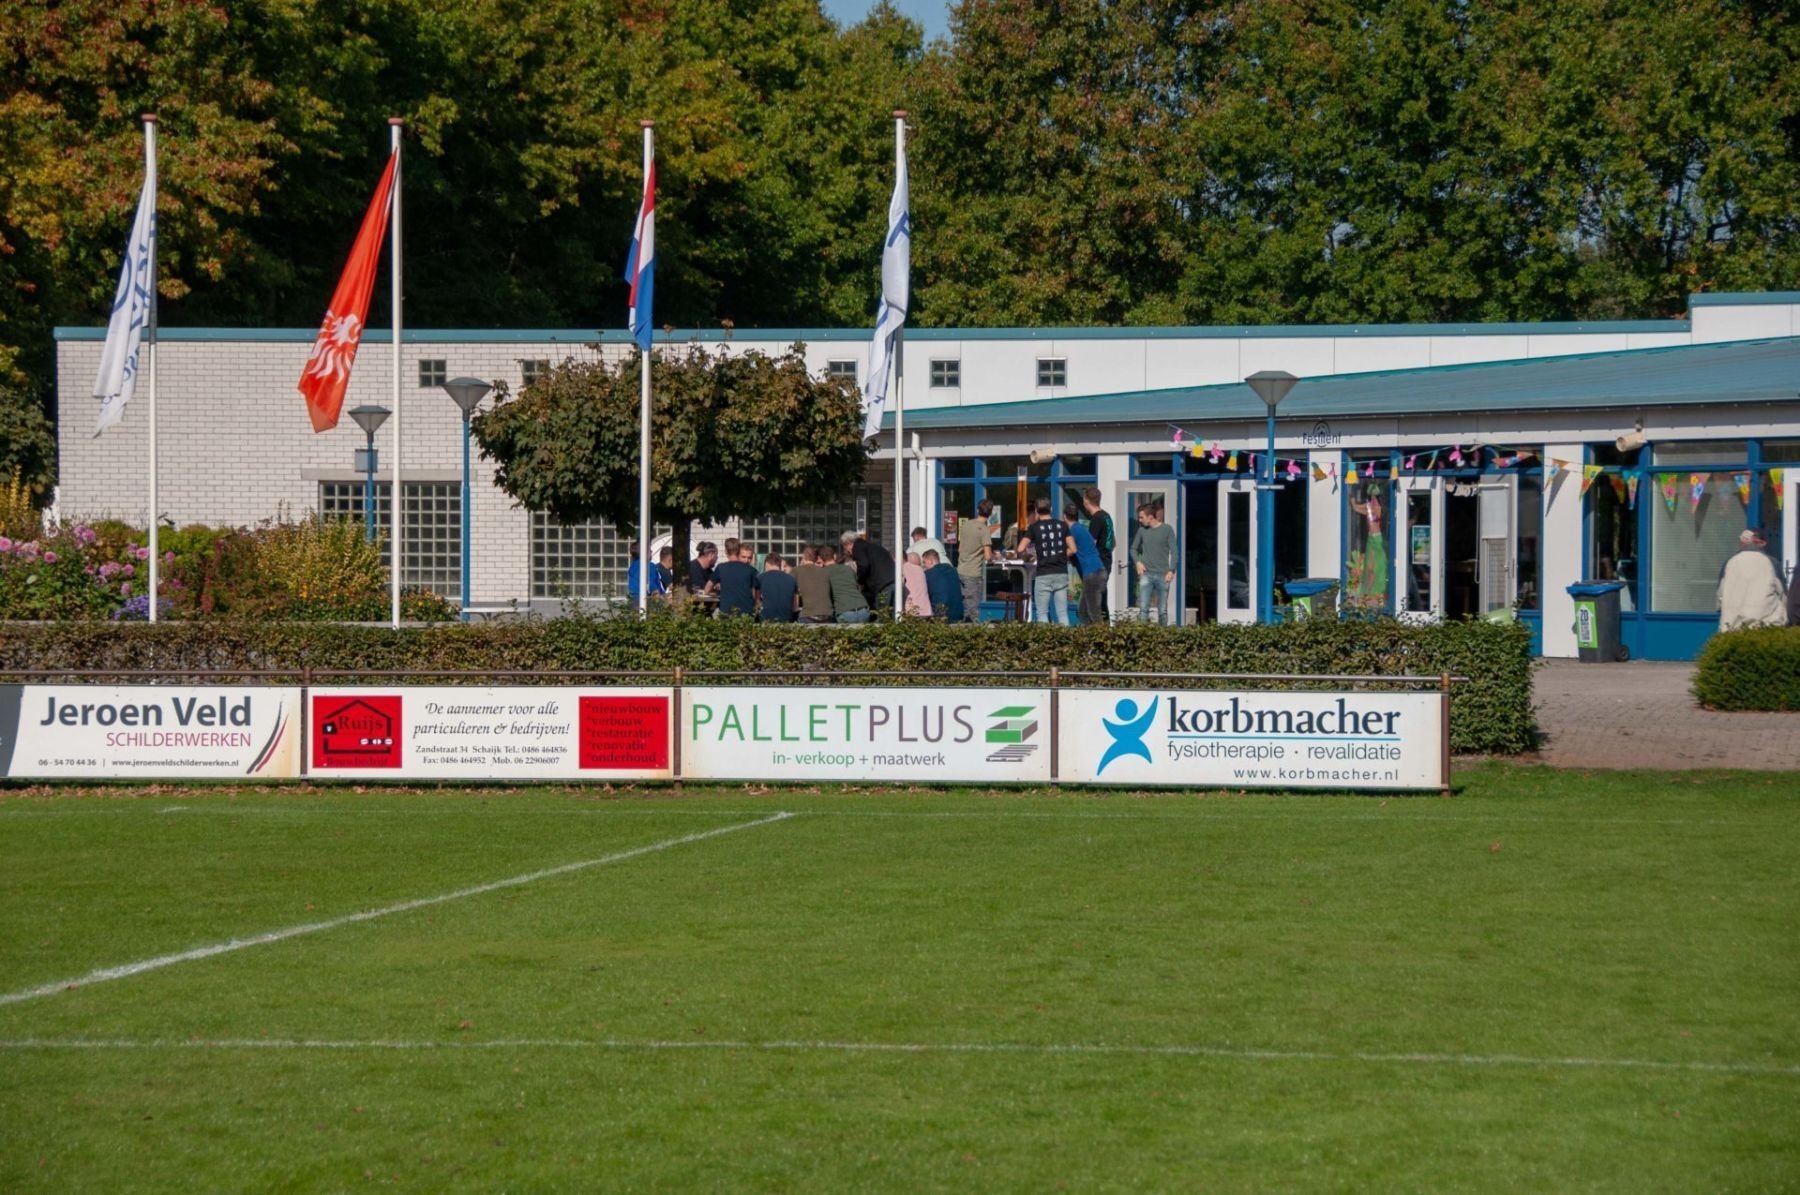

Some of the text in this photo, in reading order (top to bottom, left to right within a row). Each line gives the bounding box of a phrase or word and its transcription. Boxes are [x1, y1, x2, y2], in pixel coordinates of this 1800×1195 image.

[40, 696, 251, 727] Jeroen Veld
[425, 701, 559, 715] De aannemer voor alle
[592, 716, 643, 727] verbouw
[1167, 696, 1401, 735] korbmacher
[413, 721, 570, 740] particulieren & bedrijven!
[692, 704, 974, 743] PALLETPLUS
[106, 732, 251, 747] SCHILDERWERKEN
[592, 741, 648, 751] renovatie
[415, 745, 458, 754] Zandstraat
[472, 745, 501, 756] Schaijk
[522, 745, 540, 754] 0486
[592, 752, 657, 763] onderhoud
[1168, 740, 1402, 762] fysiotherapie revalidatie
[112, 759, 239, 767] www.jeroenveldschilderwerken.nl
[423, 756, 439, 764] Fax:
[773, 752, 791, 765] in-
[795, 752, 855, 769] verkoop
[872, 752, 946, 766] maatwerk
[1234, 767, 1399, 781] www.korbmacher.nl
